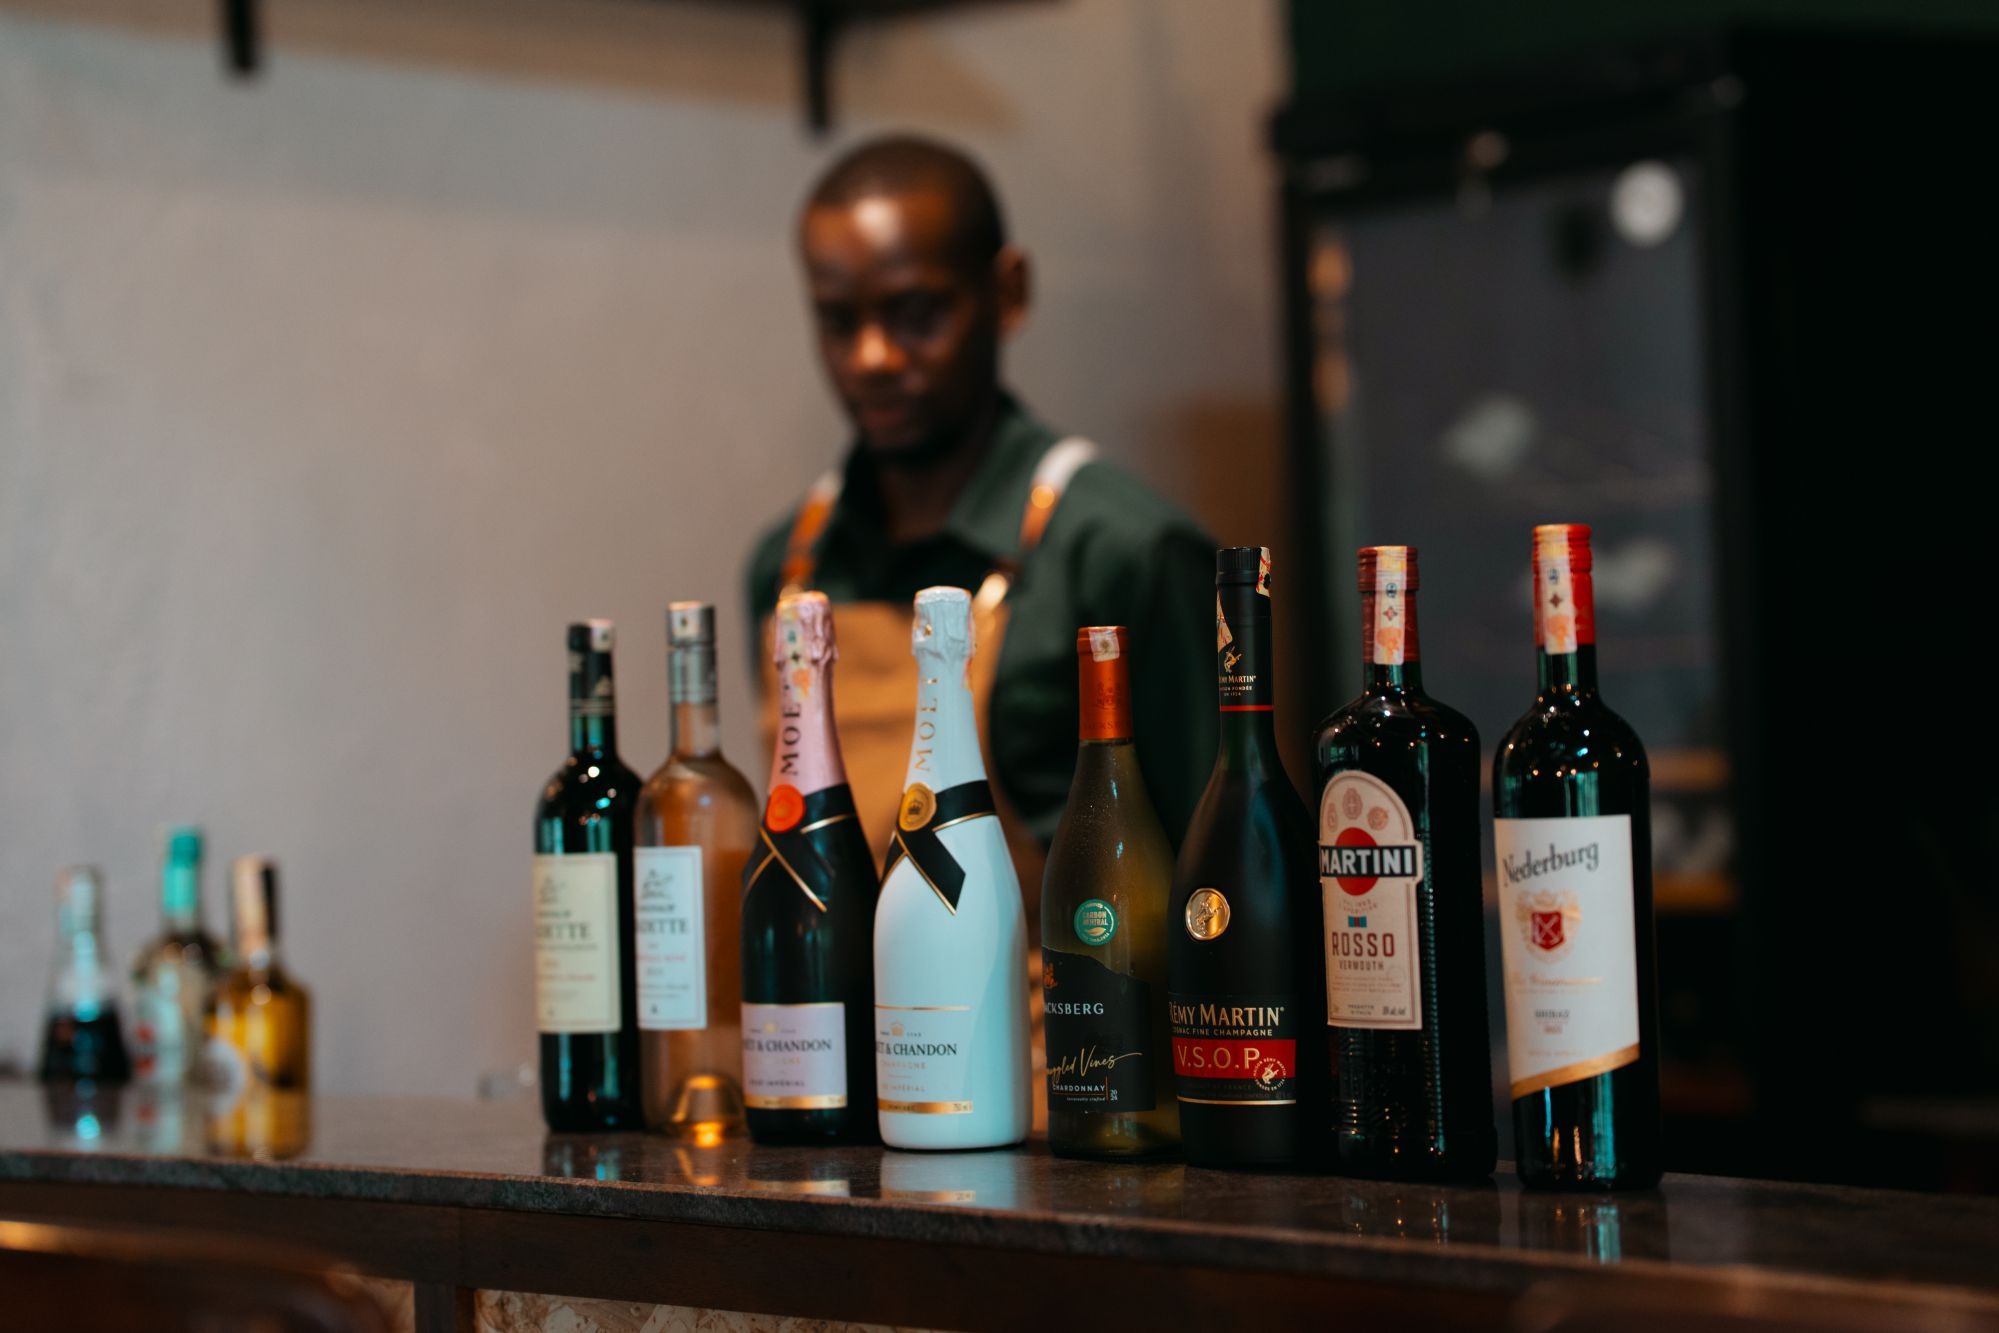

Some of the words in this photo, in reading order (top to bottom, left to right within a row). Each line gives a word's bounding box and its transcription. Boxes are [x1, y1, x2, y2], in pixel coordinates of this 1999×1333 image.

[1229, 675, 1254, 683] MARTIN
[1321, 848, 1413, 874] MARTINI
[1503, 842, 1599, 888] Nederburg
[1331, 931, 1395, 957] ROSSO
[1339, 960, 1384, 971] VERMOUTH
[1200, 1003, 1280, 1027] MARTIN
[1192, 1028, 1210, 1036] FINE
[1213, 1028, 1273, 1037] CHAMPAGNE
[766, 1040, 832, 1052] CHANDON
[893, 1043, 957, 1056] CHANDON
[1081, 1045, 1143, 1076] Vines
[1052, 1084, 1105, 1092] CHARDONNAY
